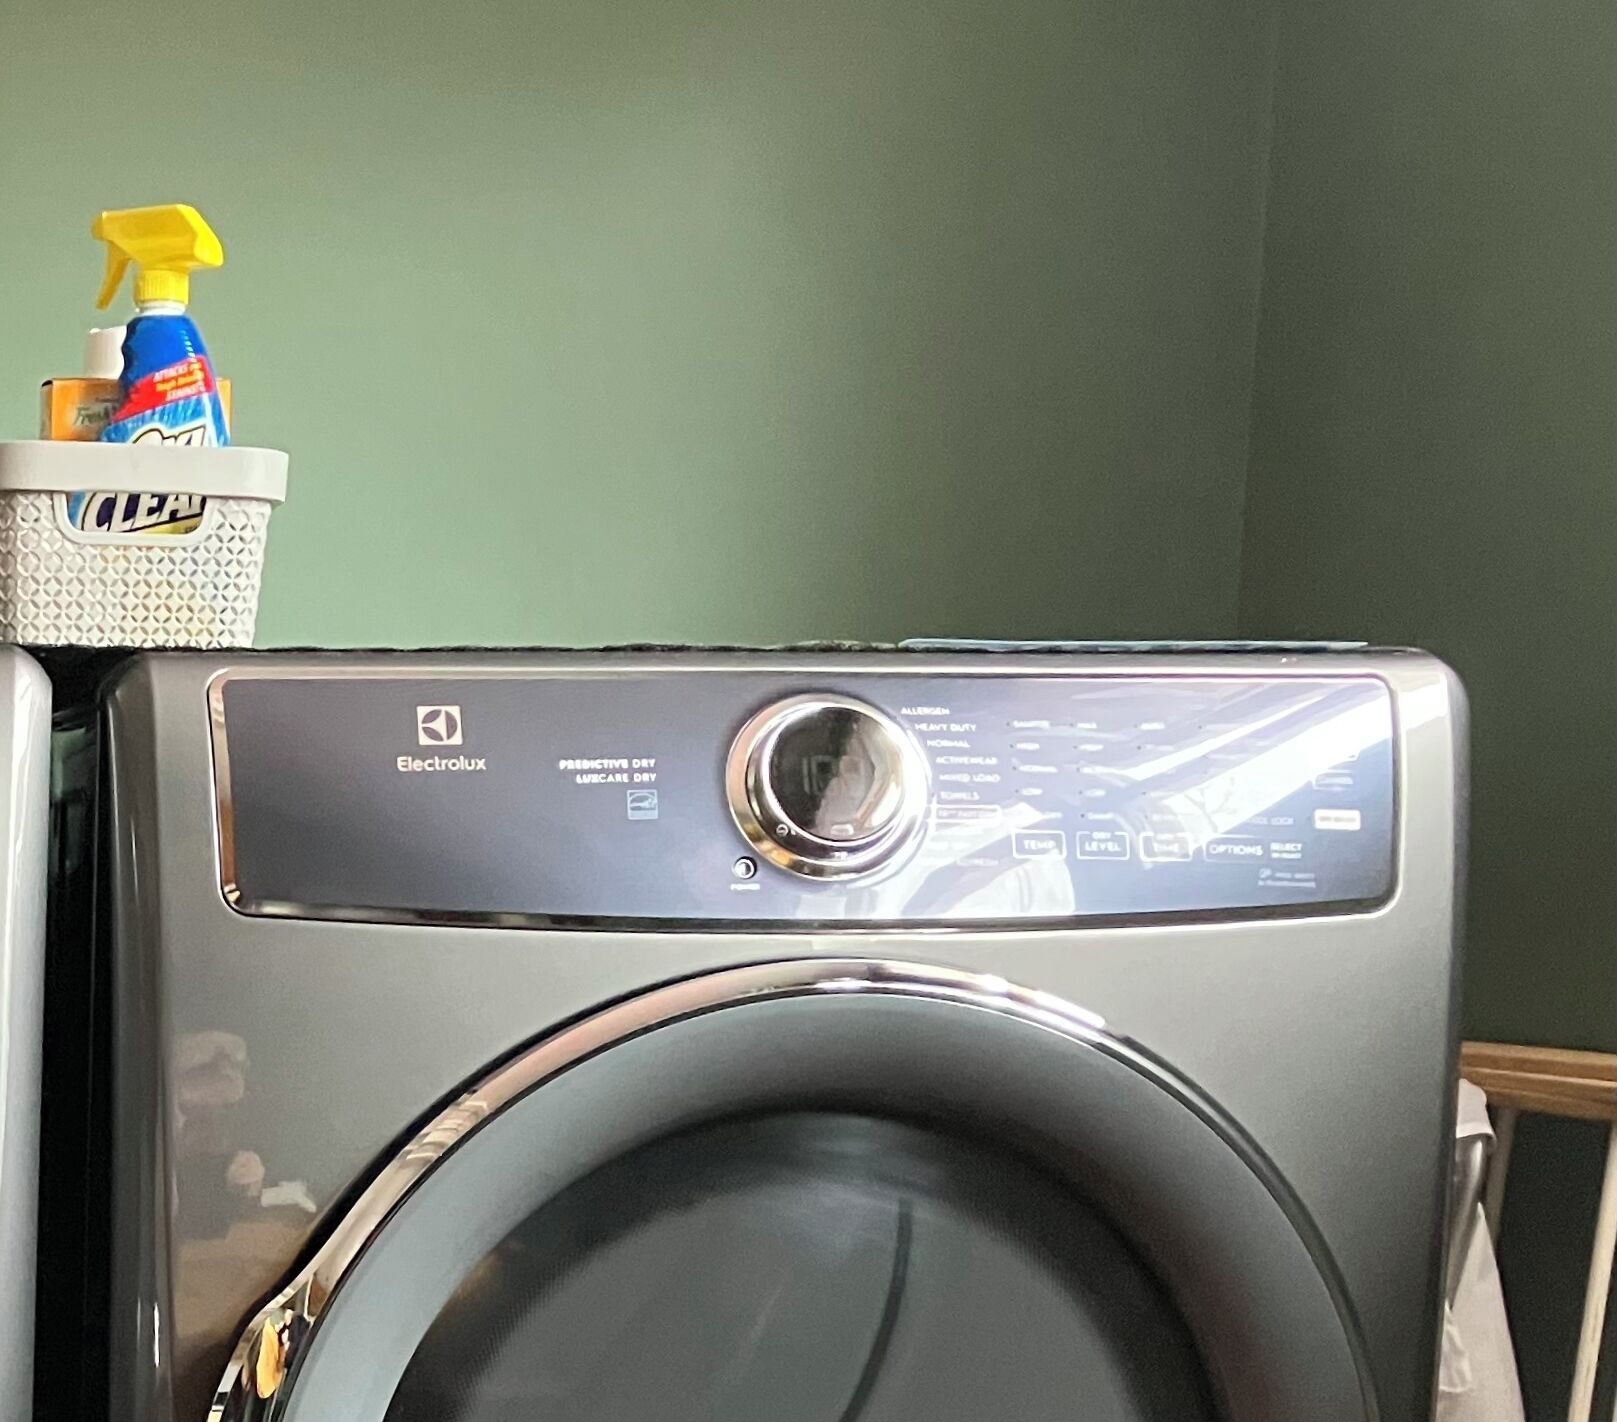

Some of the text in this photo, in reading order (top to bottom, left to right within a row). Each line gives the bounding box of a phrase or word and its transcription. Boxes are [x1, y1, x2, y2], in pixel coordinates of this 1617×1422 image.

[901, 706, 950, 715] ALLERGEN
[915, 723, 976, 732] HEAVY DUTY
[927, 739, 971, 748] NORMAL
[396, 755, 486, 772] Electrolux
[559, 759, 656, 769] PREDICTIVE DRY
[936, 756, 998, 765] ACTIVEWEAR
[576, 773, 656, 784] LUXCARE DRY
[1023, 839, 1057, 850] TEMP
[1085, 841, 1121, 851] LEVEL
[1209, 844, 1264, 856] OPTIONS
